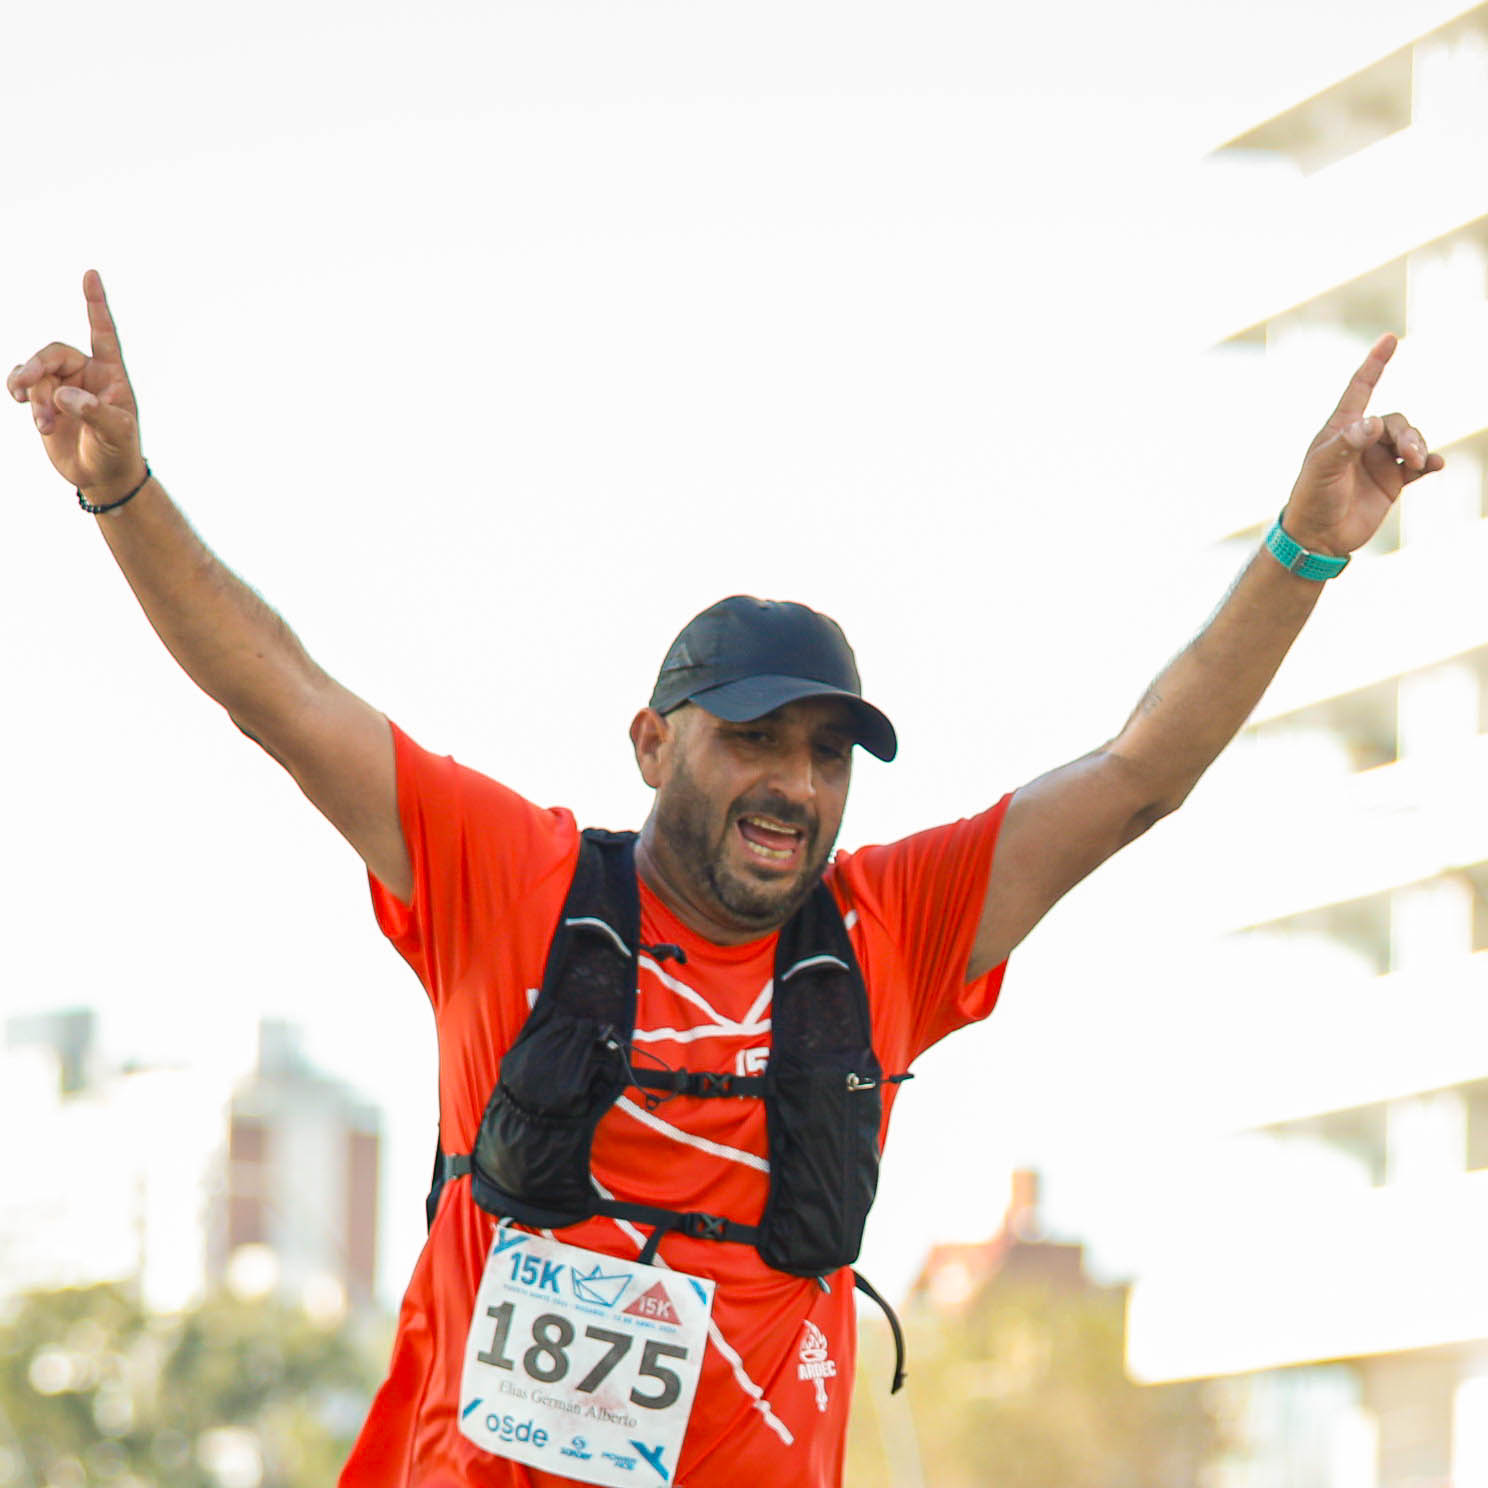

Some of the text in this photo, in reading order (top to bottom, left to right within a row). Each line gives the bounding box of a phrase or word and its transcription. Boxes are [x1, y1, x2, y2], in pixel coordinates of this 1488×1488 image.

[509, 1252, 566, 1294] 15K
[638, 1295, 672, 1320] 15K
[476, 1301, 690, 1411] 1875
[485, 1411, 549, 1448] osde
[585, 1403, 638, 1428] Alberto
